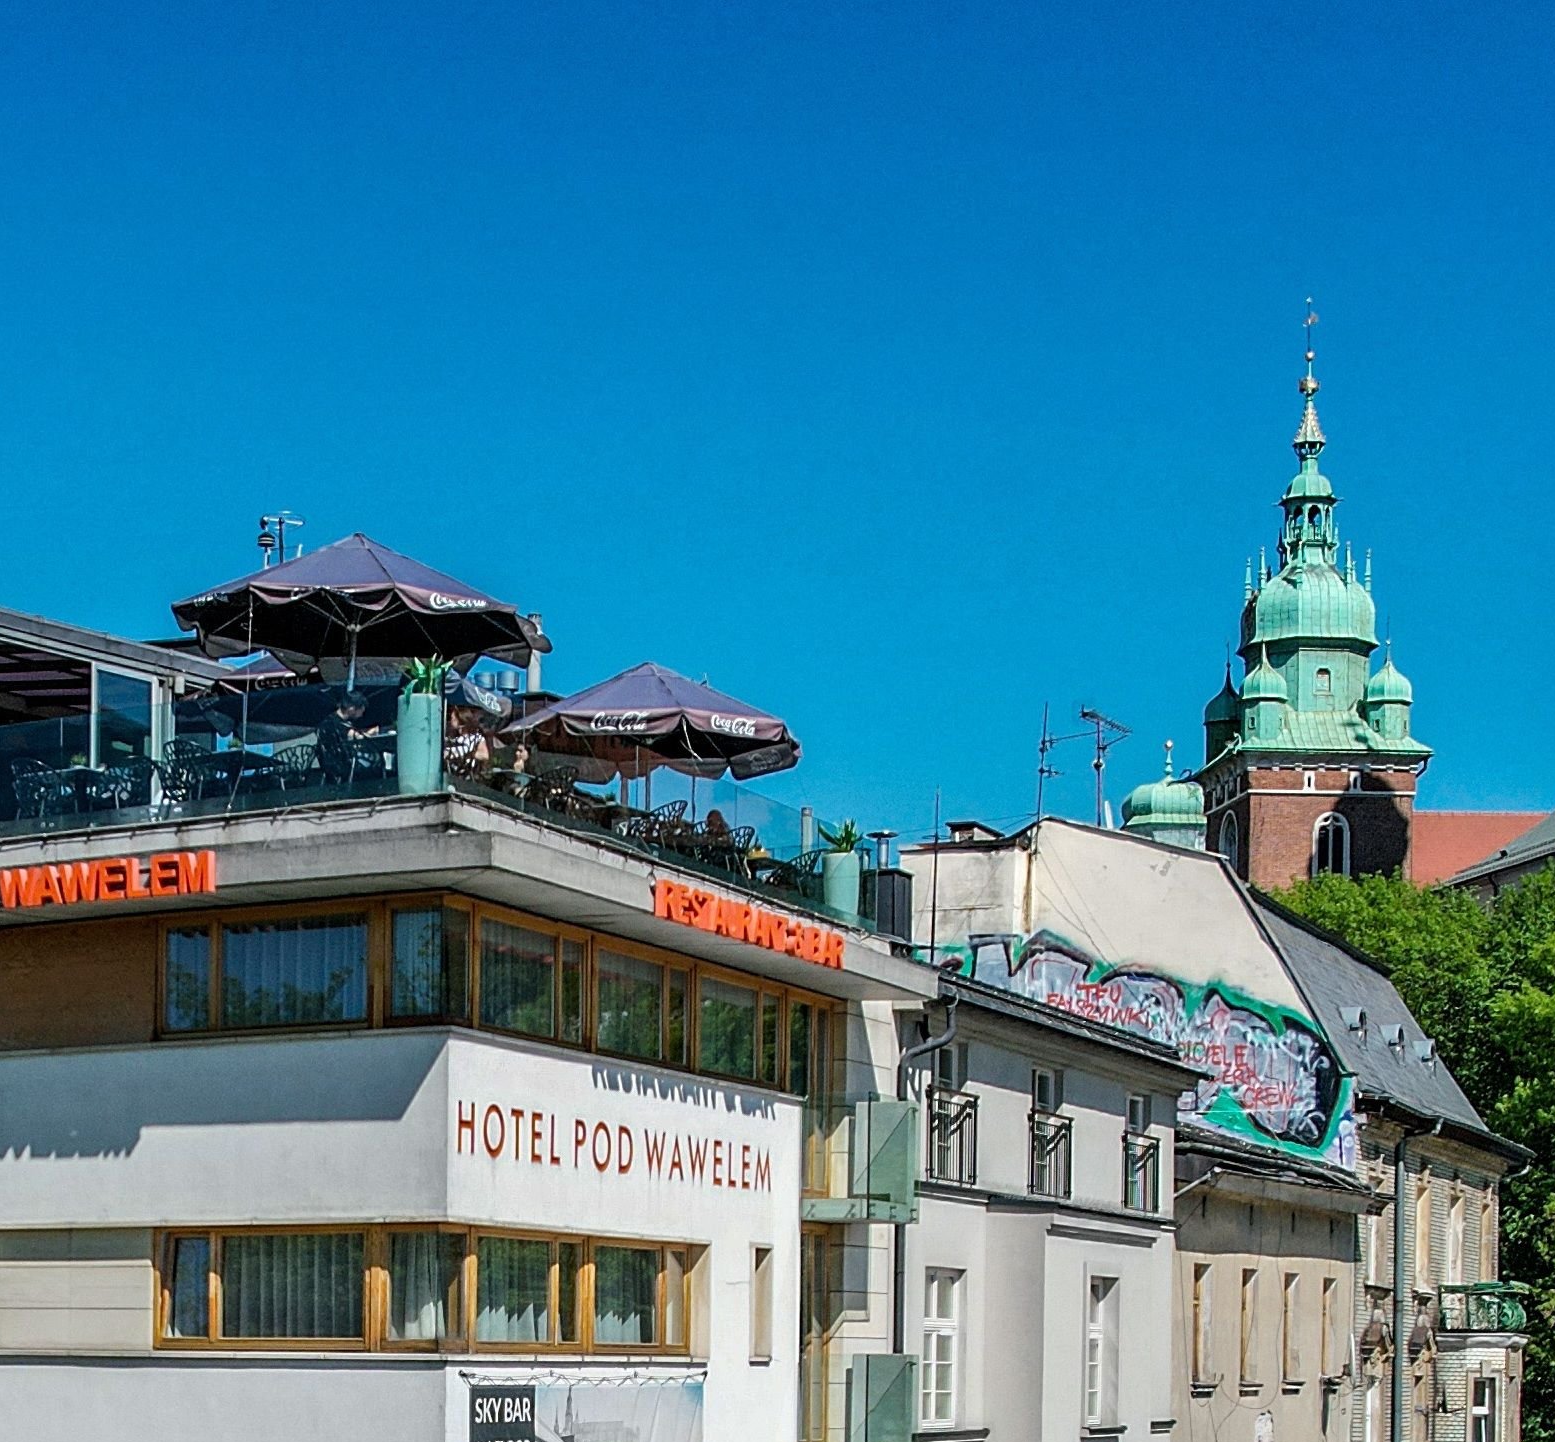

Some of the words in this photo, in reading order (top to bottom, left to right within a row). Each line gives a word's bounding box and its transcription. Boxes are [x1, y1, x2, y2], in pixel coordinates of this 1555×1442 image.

[457, 1100, 561, 1166] HOTEL
[574, 1118, 634, 1175] POD
[644, 1128, 772, 1192] WAWELEM
[474, 1397, 502, 1424] SKY
[504, 1397, 532, 1423] BAR
